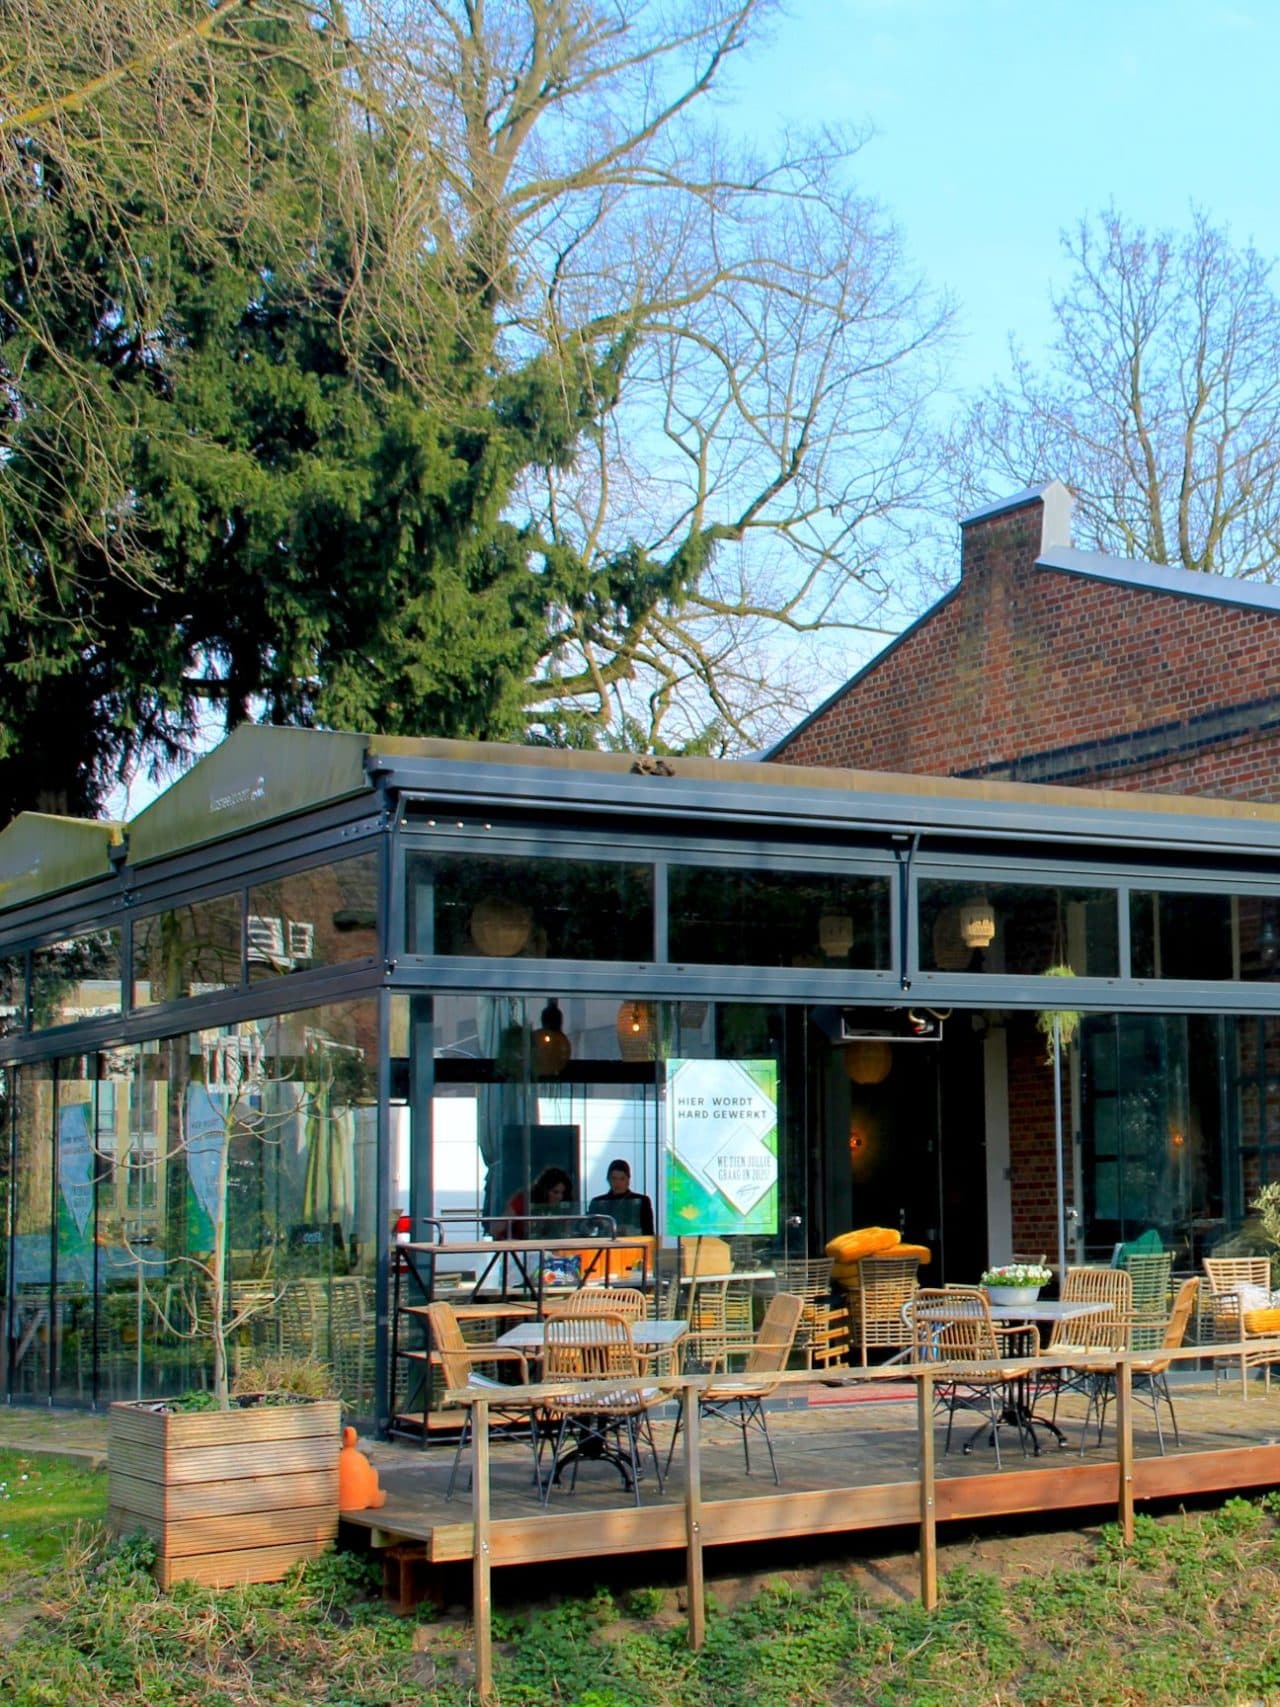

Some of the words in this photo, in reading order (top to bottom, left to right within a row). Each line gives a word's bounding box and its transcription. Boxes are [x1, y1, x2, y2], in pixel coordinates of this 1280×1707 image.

[678, 1097, 704, 1106] HIER
[712, 1097, 753, 1106] WORDT
[678, 1110, 709, 1119] HARD
[713, 1110, 767, 1119] GEWERKT
